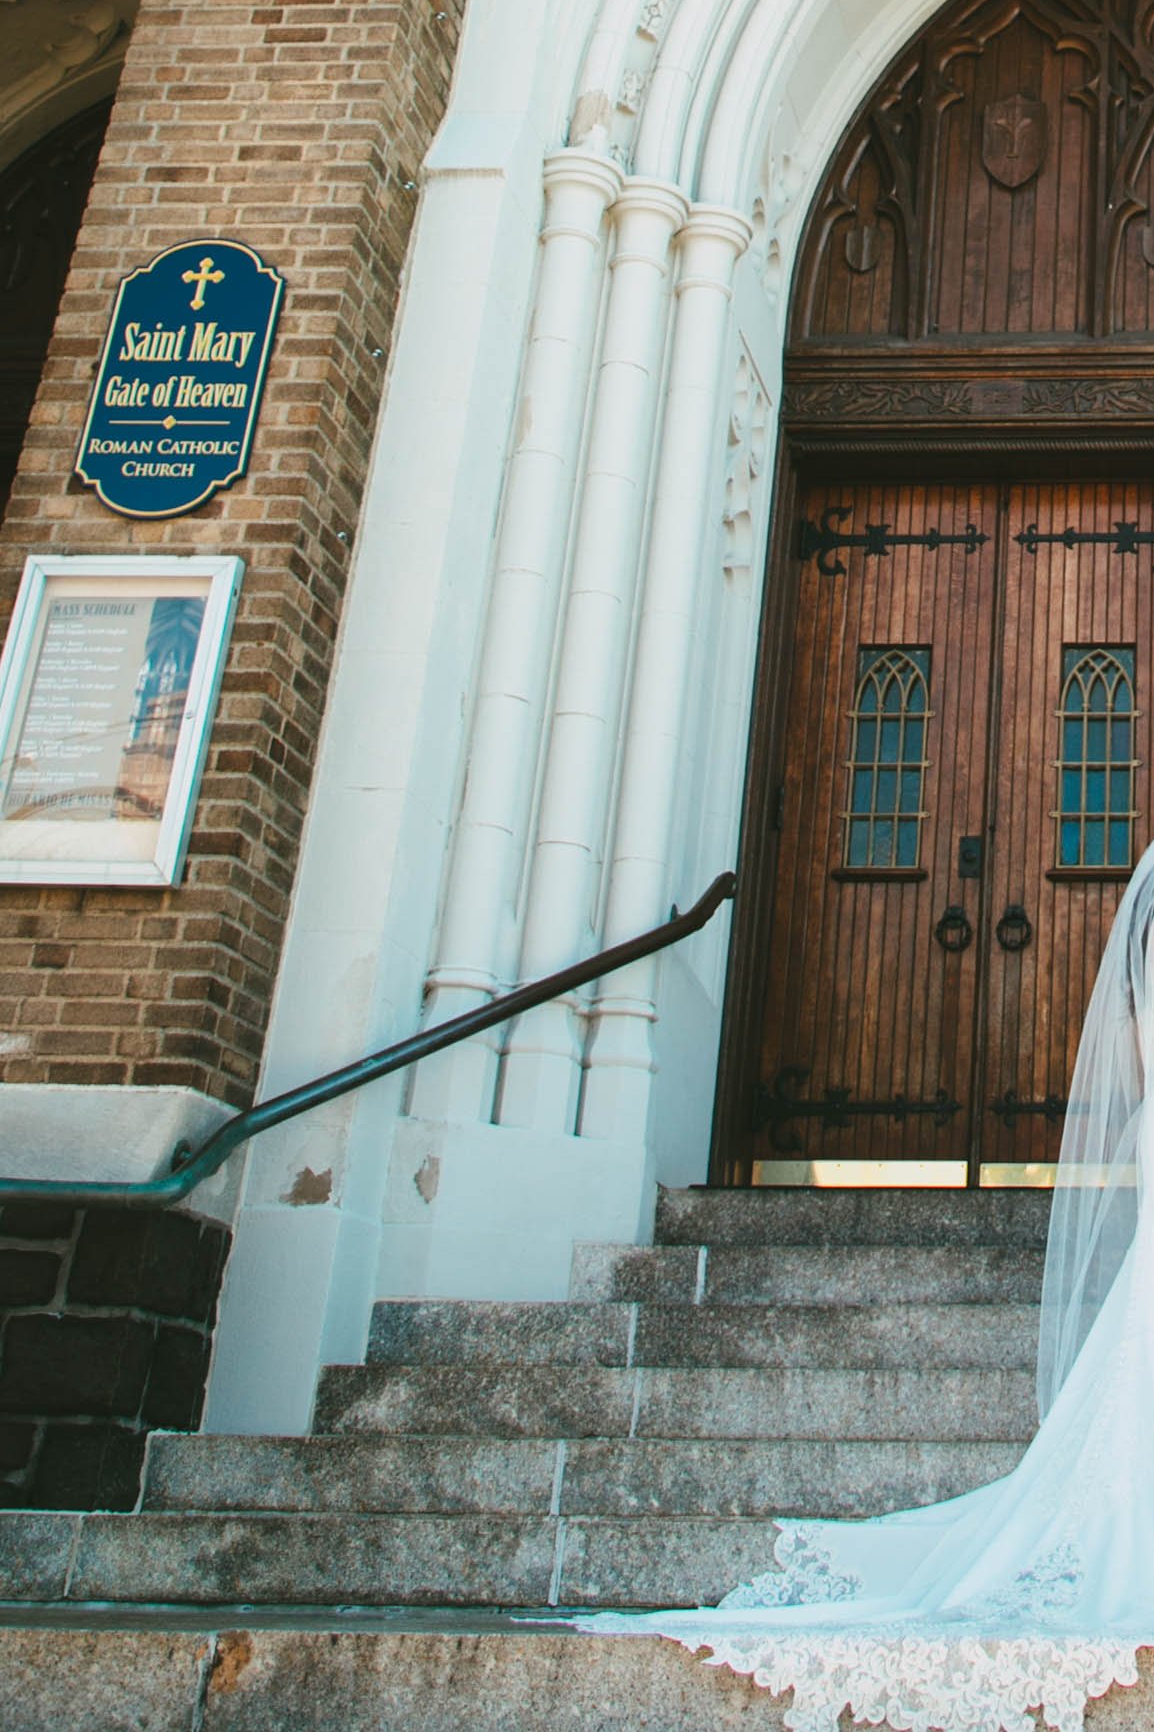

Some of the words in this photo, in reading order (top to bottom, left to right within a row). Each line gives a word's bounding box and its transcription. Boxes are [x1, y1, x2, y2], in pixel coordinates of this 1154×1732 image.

[119, 322, 186, 362] Saint
[187, 322, 256, 368] Mary
[104, 376, 149, 407] Gate
[152, 376, 178, 407] of
[174, 376, 248, 408] Heaven
[88, 438, 153, 454] ROMAN
[157, 438, 240, 455] CATHOLIC
[121, 460, 195, 477] CHURCH
[53, 603, 82, 615] MASS
